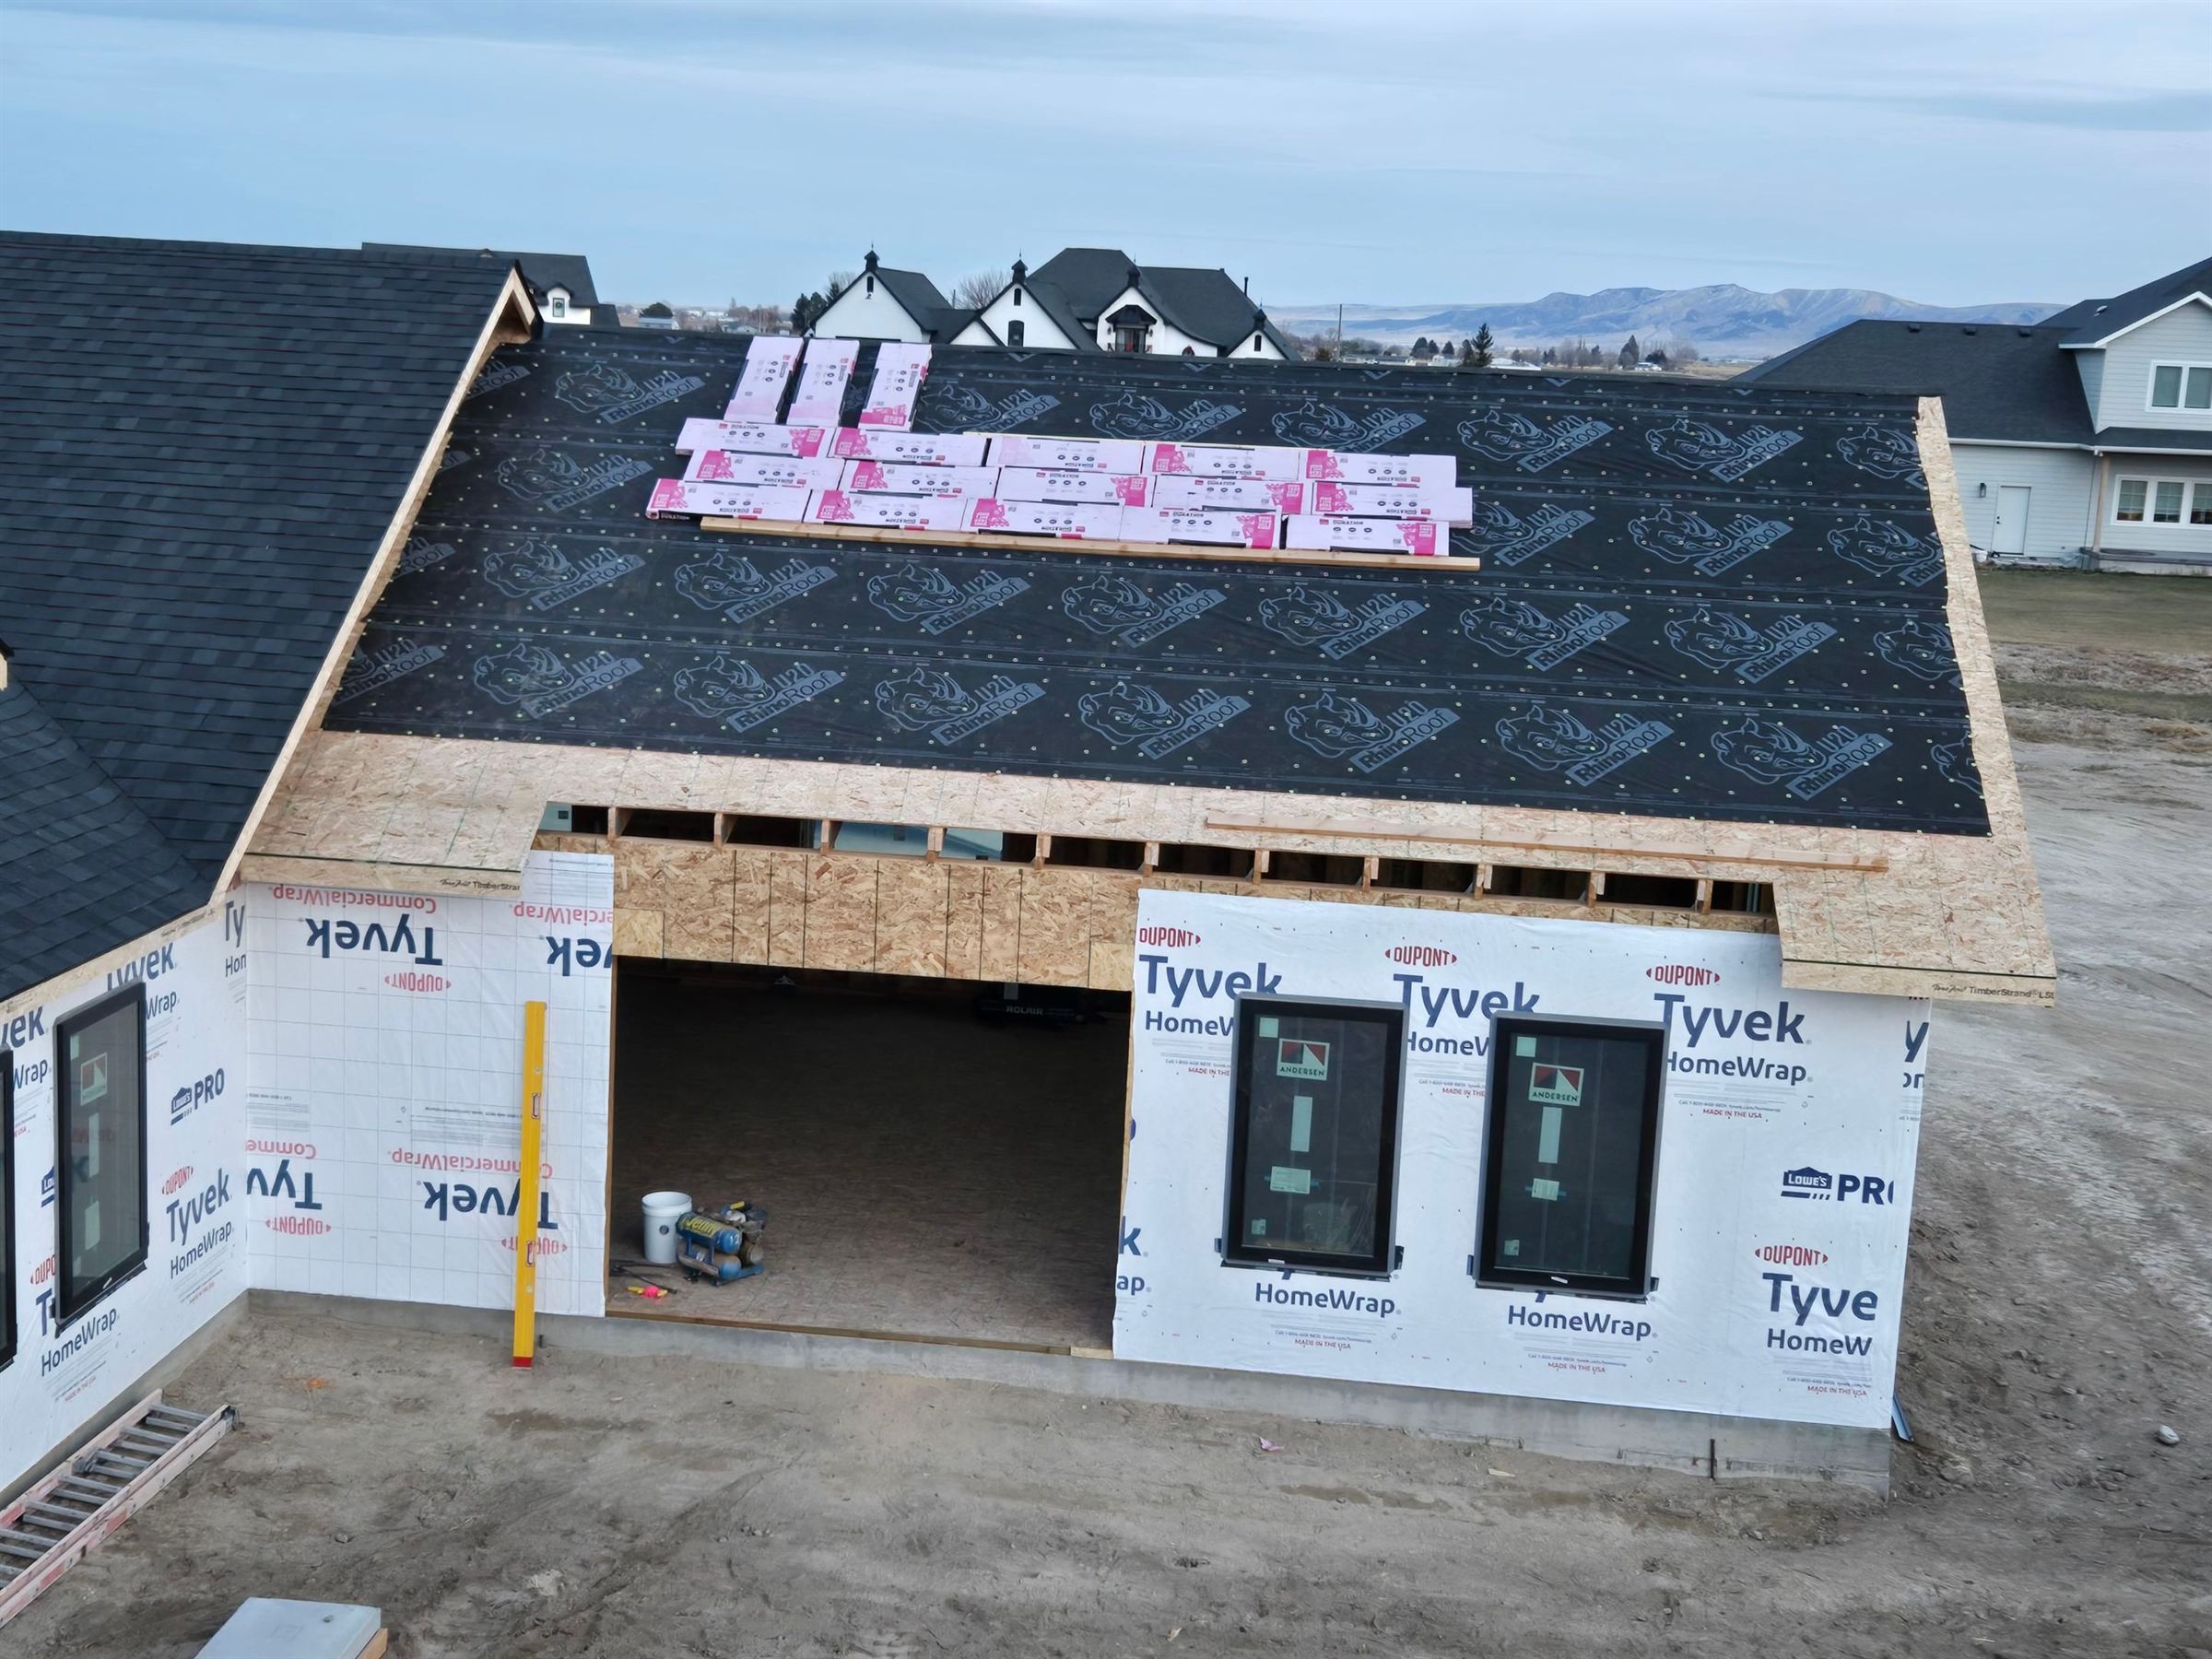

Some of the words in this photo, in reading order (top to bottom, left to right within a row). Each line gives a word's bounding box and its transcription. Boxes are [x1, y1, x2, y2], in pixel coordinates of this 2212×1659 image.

[274, 884, 437, 913] CommercialWrap
[305, 913, 442, 966] Tyvek
[1139, 927, 1193, 947] DUPONT
[1394, 947, 1450, 967] DUPONT
[392, 972, 443, 993] DUPONT
[1139, 954, 1282, 1008] Tyvek
[1655, 966, 1712, 986] DUPONT
[146, 992, 177, 1020] Wrap
[1393, 973, 1540, 1027] Tyvek
[1654, 993, 1805, 1048] Tyvek
[1279, 1066, 1324, 1077] ANDERSEN
[1667, 1052, 1806, 1086] HomeWrap
[194, 1067, 225, 1110] PRO
[1532, 1091, 1578, 1102] ANDERSEN
[166, 1165, 190, 1194] DUPONT
[246, 1159, 323, 1210] Tyv
[1788, 1174, 1827, 1187] LOWE'S
[166, 1168, 229, 1245] Tyvek
[273, 1217, 323, 1235] DUPONT
[171, 1221, 231, 1278] HomeWrap
[1764, 1246, 1820, 1265] DUPONT
[1255, 1283, 1394, 1318] HomeWrap
[1762, 1272, 1878, 1326] Tyve
[1508, 1305, 1652, 1341] HomeWrap
[41, 1308, 117, 1377] HomeWrap
[1767, 1328, 1873, 1356] HomeW
